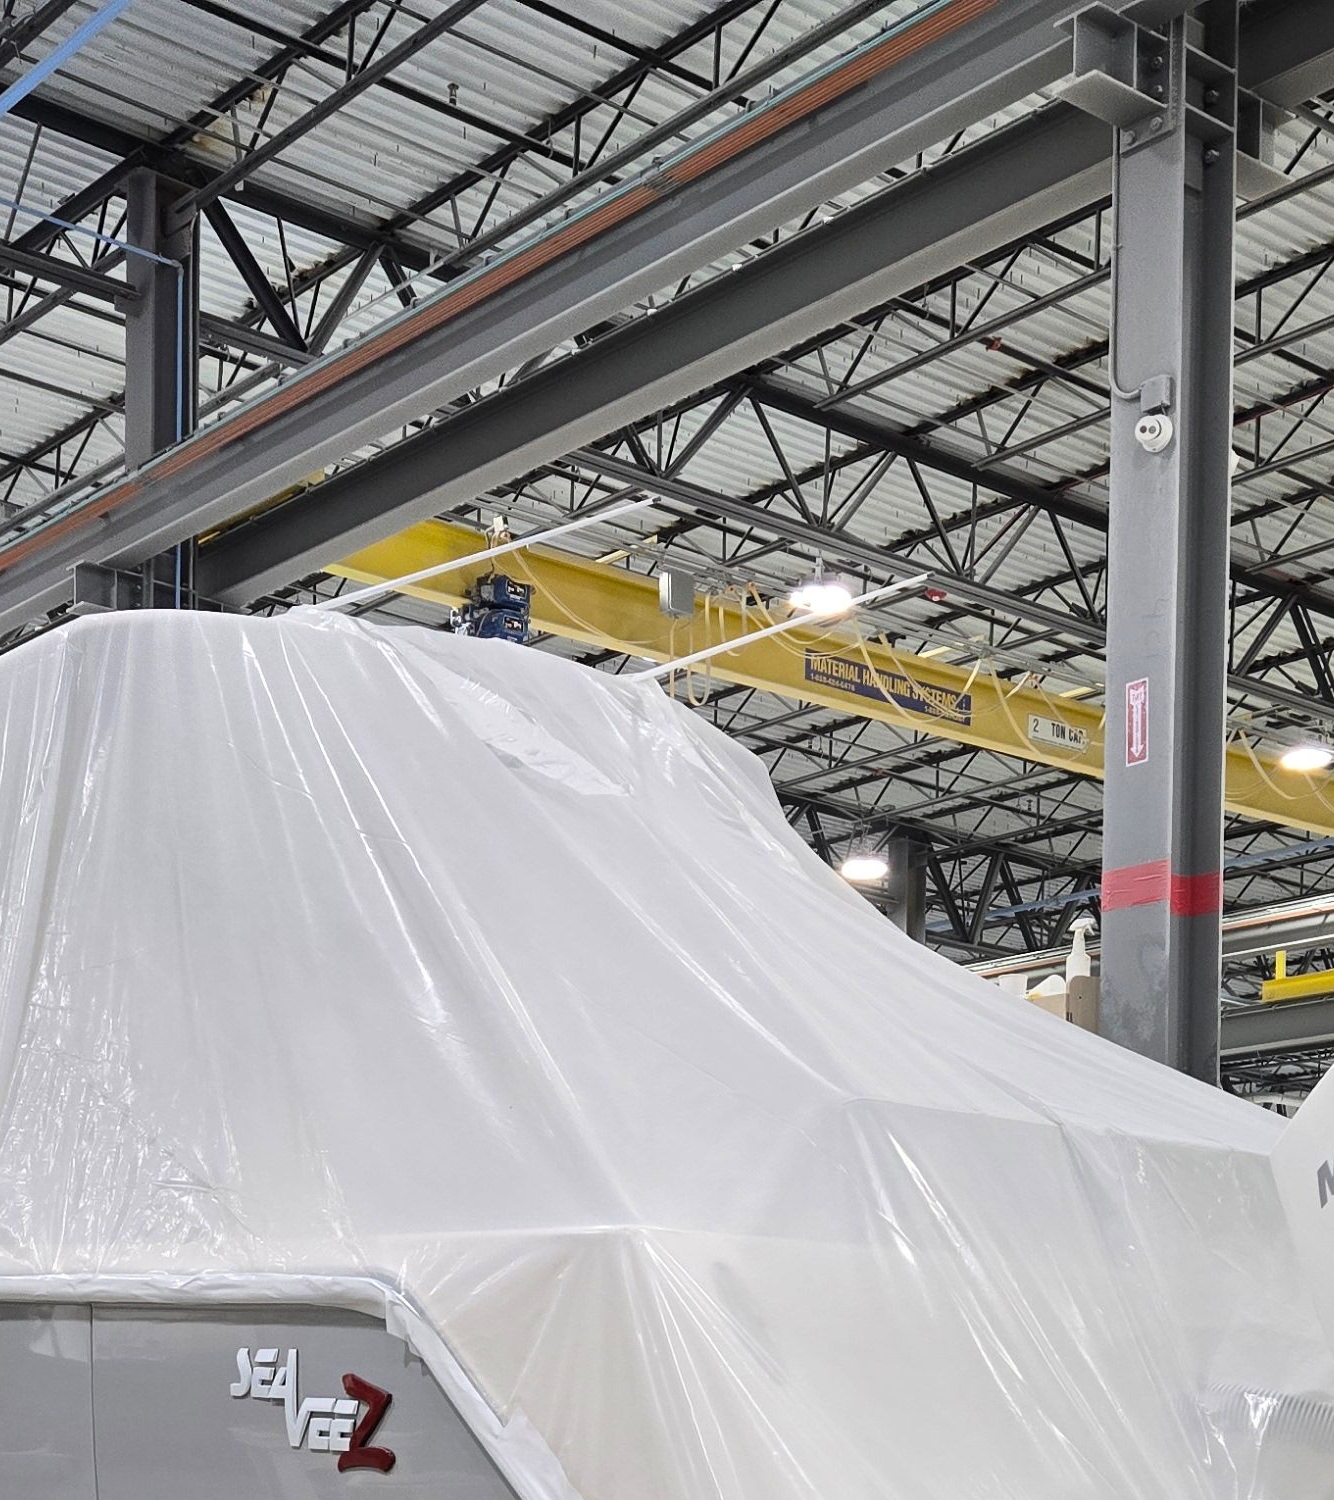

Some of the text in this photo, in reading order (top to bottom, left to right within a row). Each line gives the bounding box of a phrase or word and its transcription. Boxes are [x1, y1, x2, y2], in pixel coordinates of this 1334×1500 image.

[810, 655, 861, 683] MATERIAL
[862, 668, 911, 698] HANDLING
[1033, 718, 1039, 733] 2
[1051, 722, 1066, 740] TON
